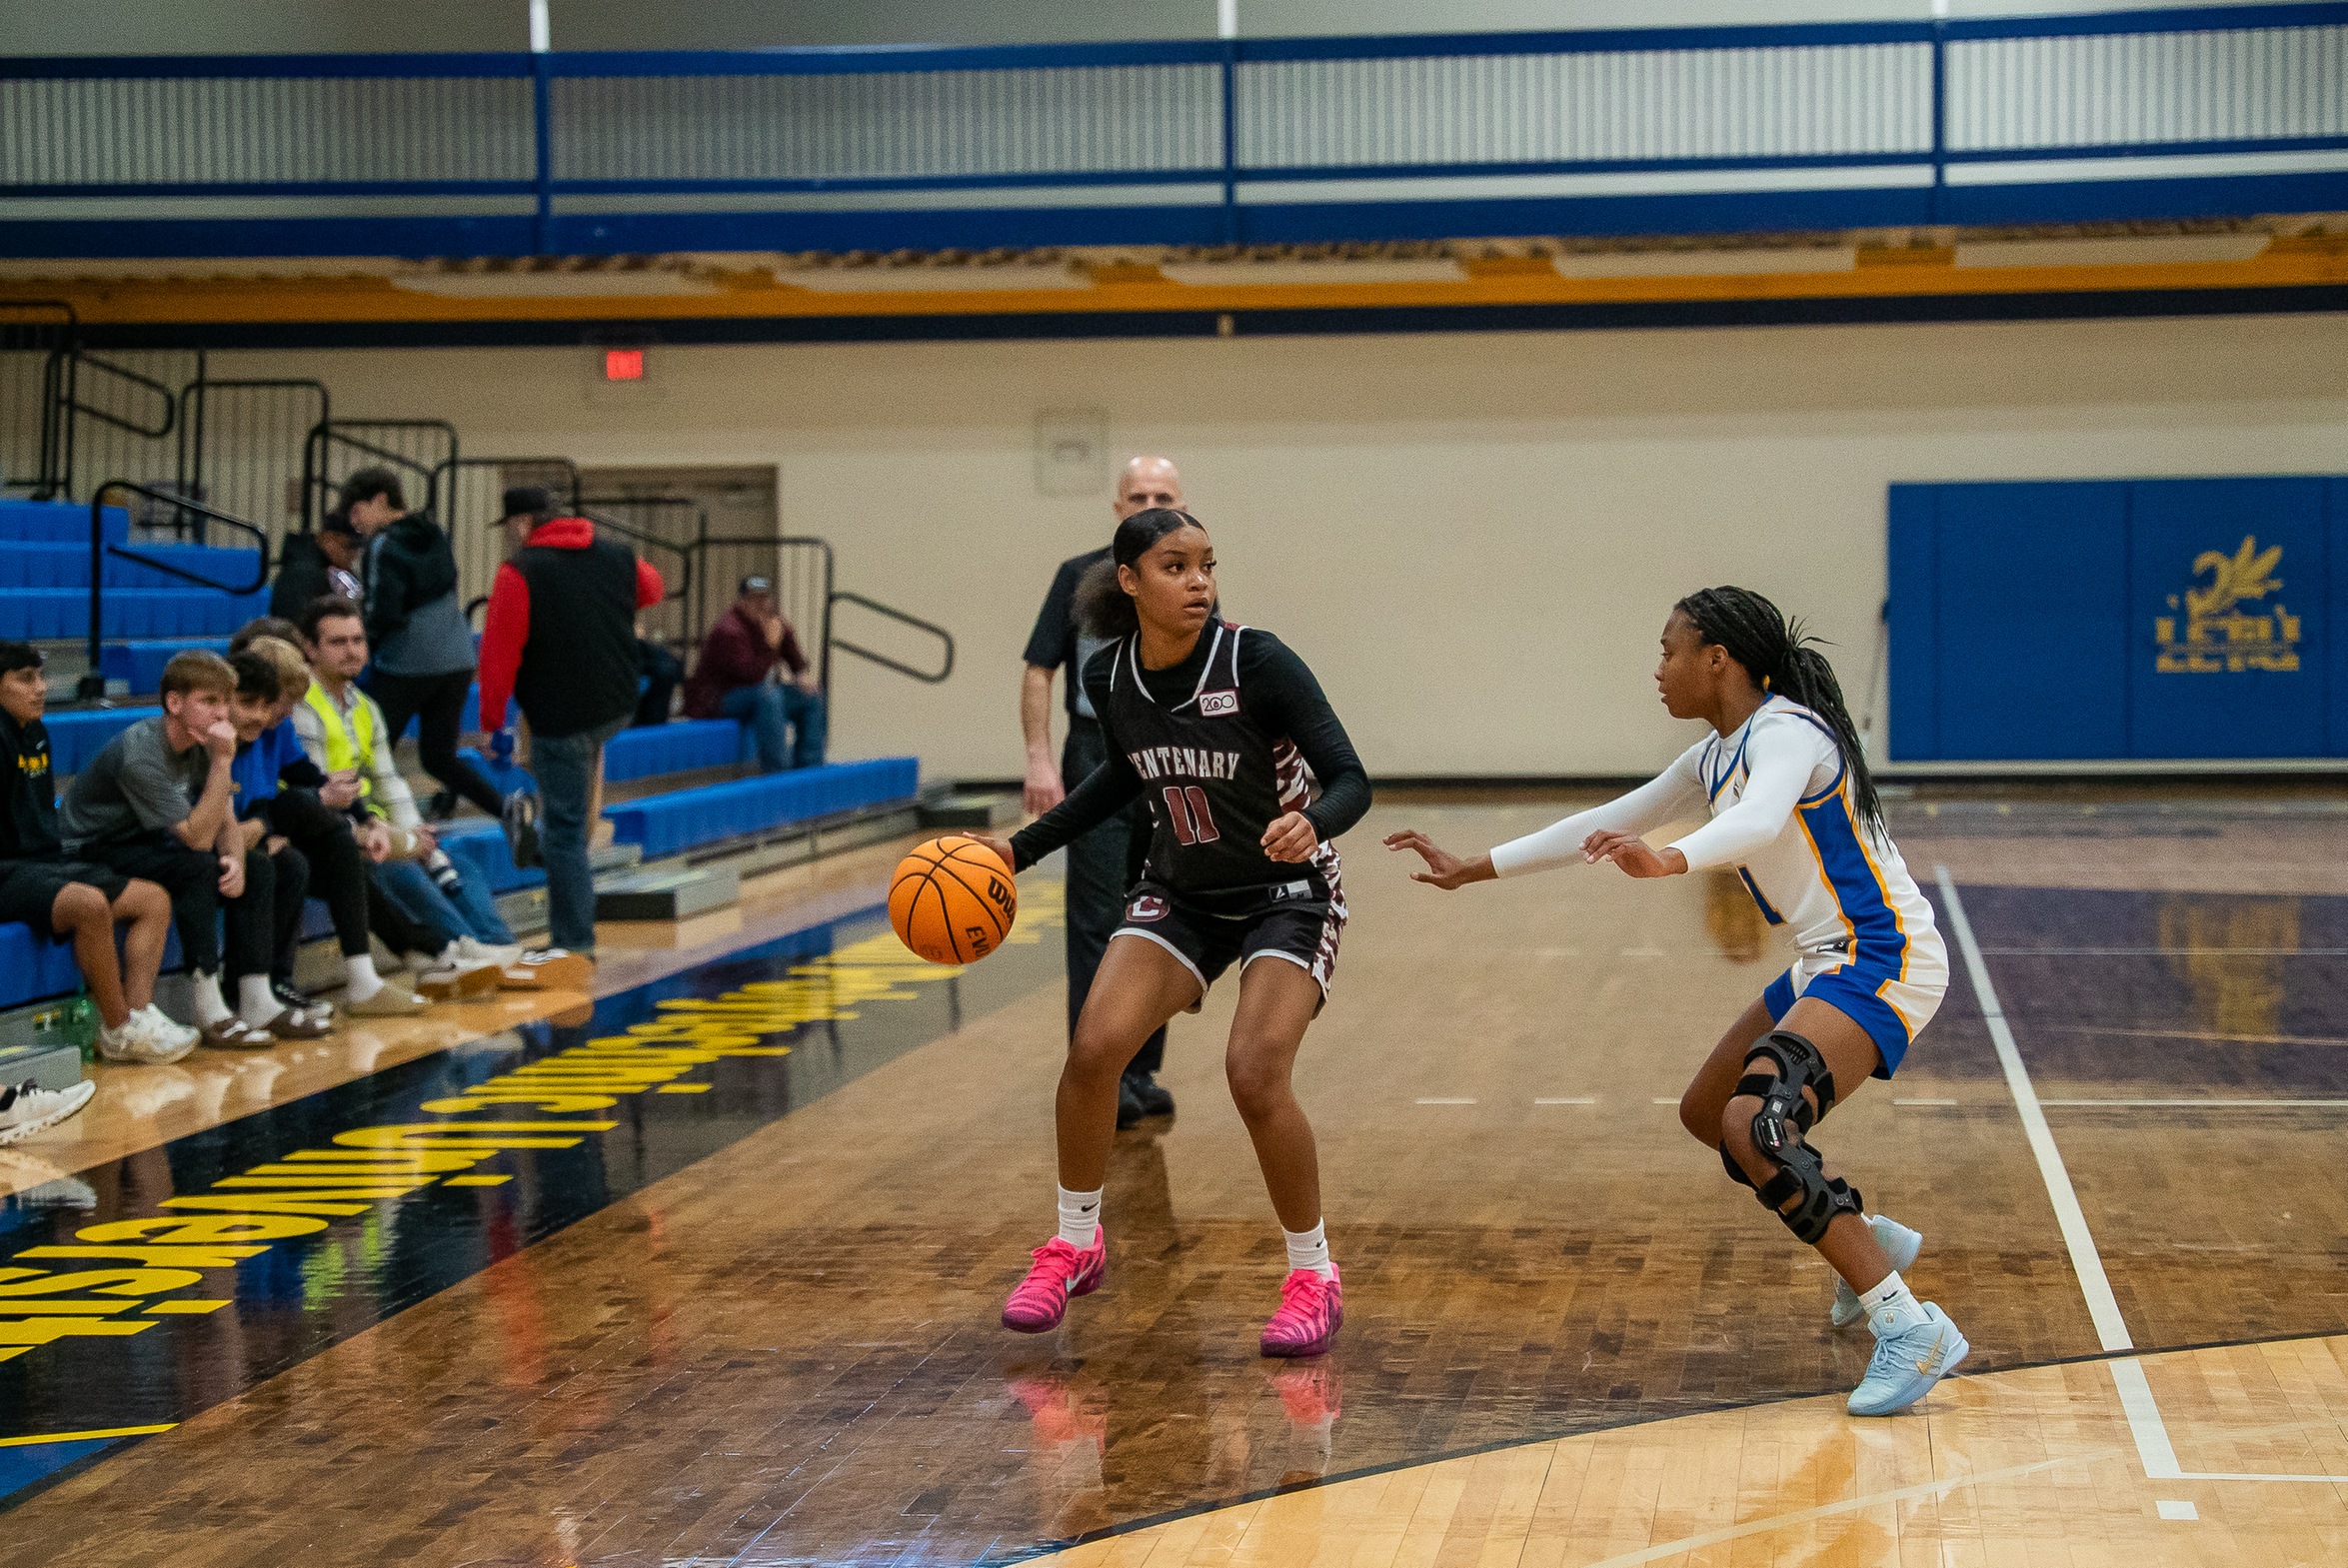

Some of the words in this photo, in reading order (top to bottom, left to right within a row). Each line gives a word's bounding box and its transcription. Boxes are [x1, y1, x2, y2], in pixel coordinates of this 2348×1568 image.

[1201, 695, 1235, 713] 200
[1128, 747, 1240, 781] ENTENARY
[1163, 785, 1220, 846] 11
[0, 1119, 619, 1362] Universit
